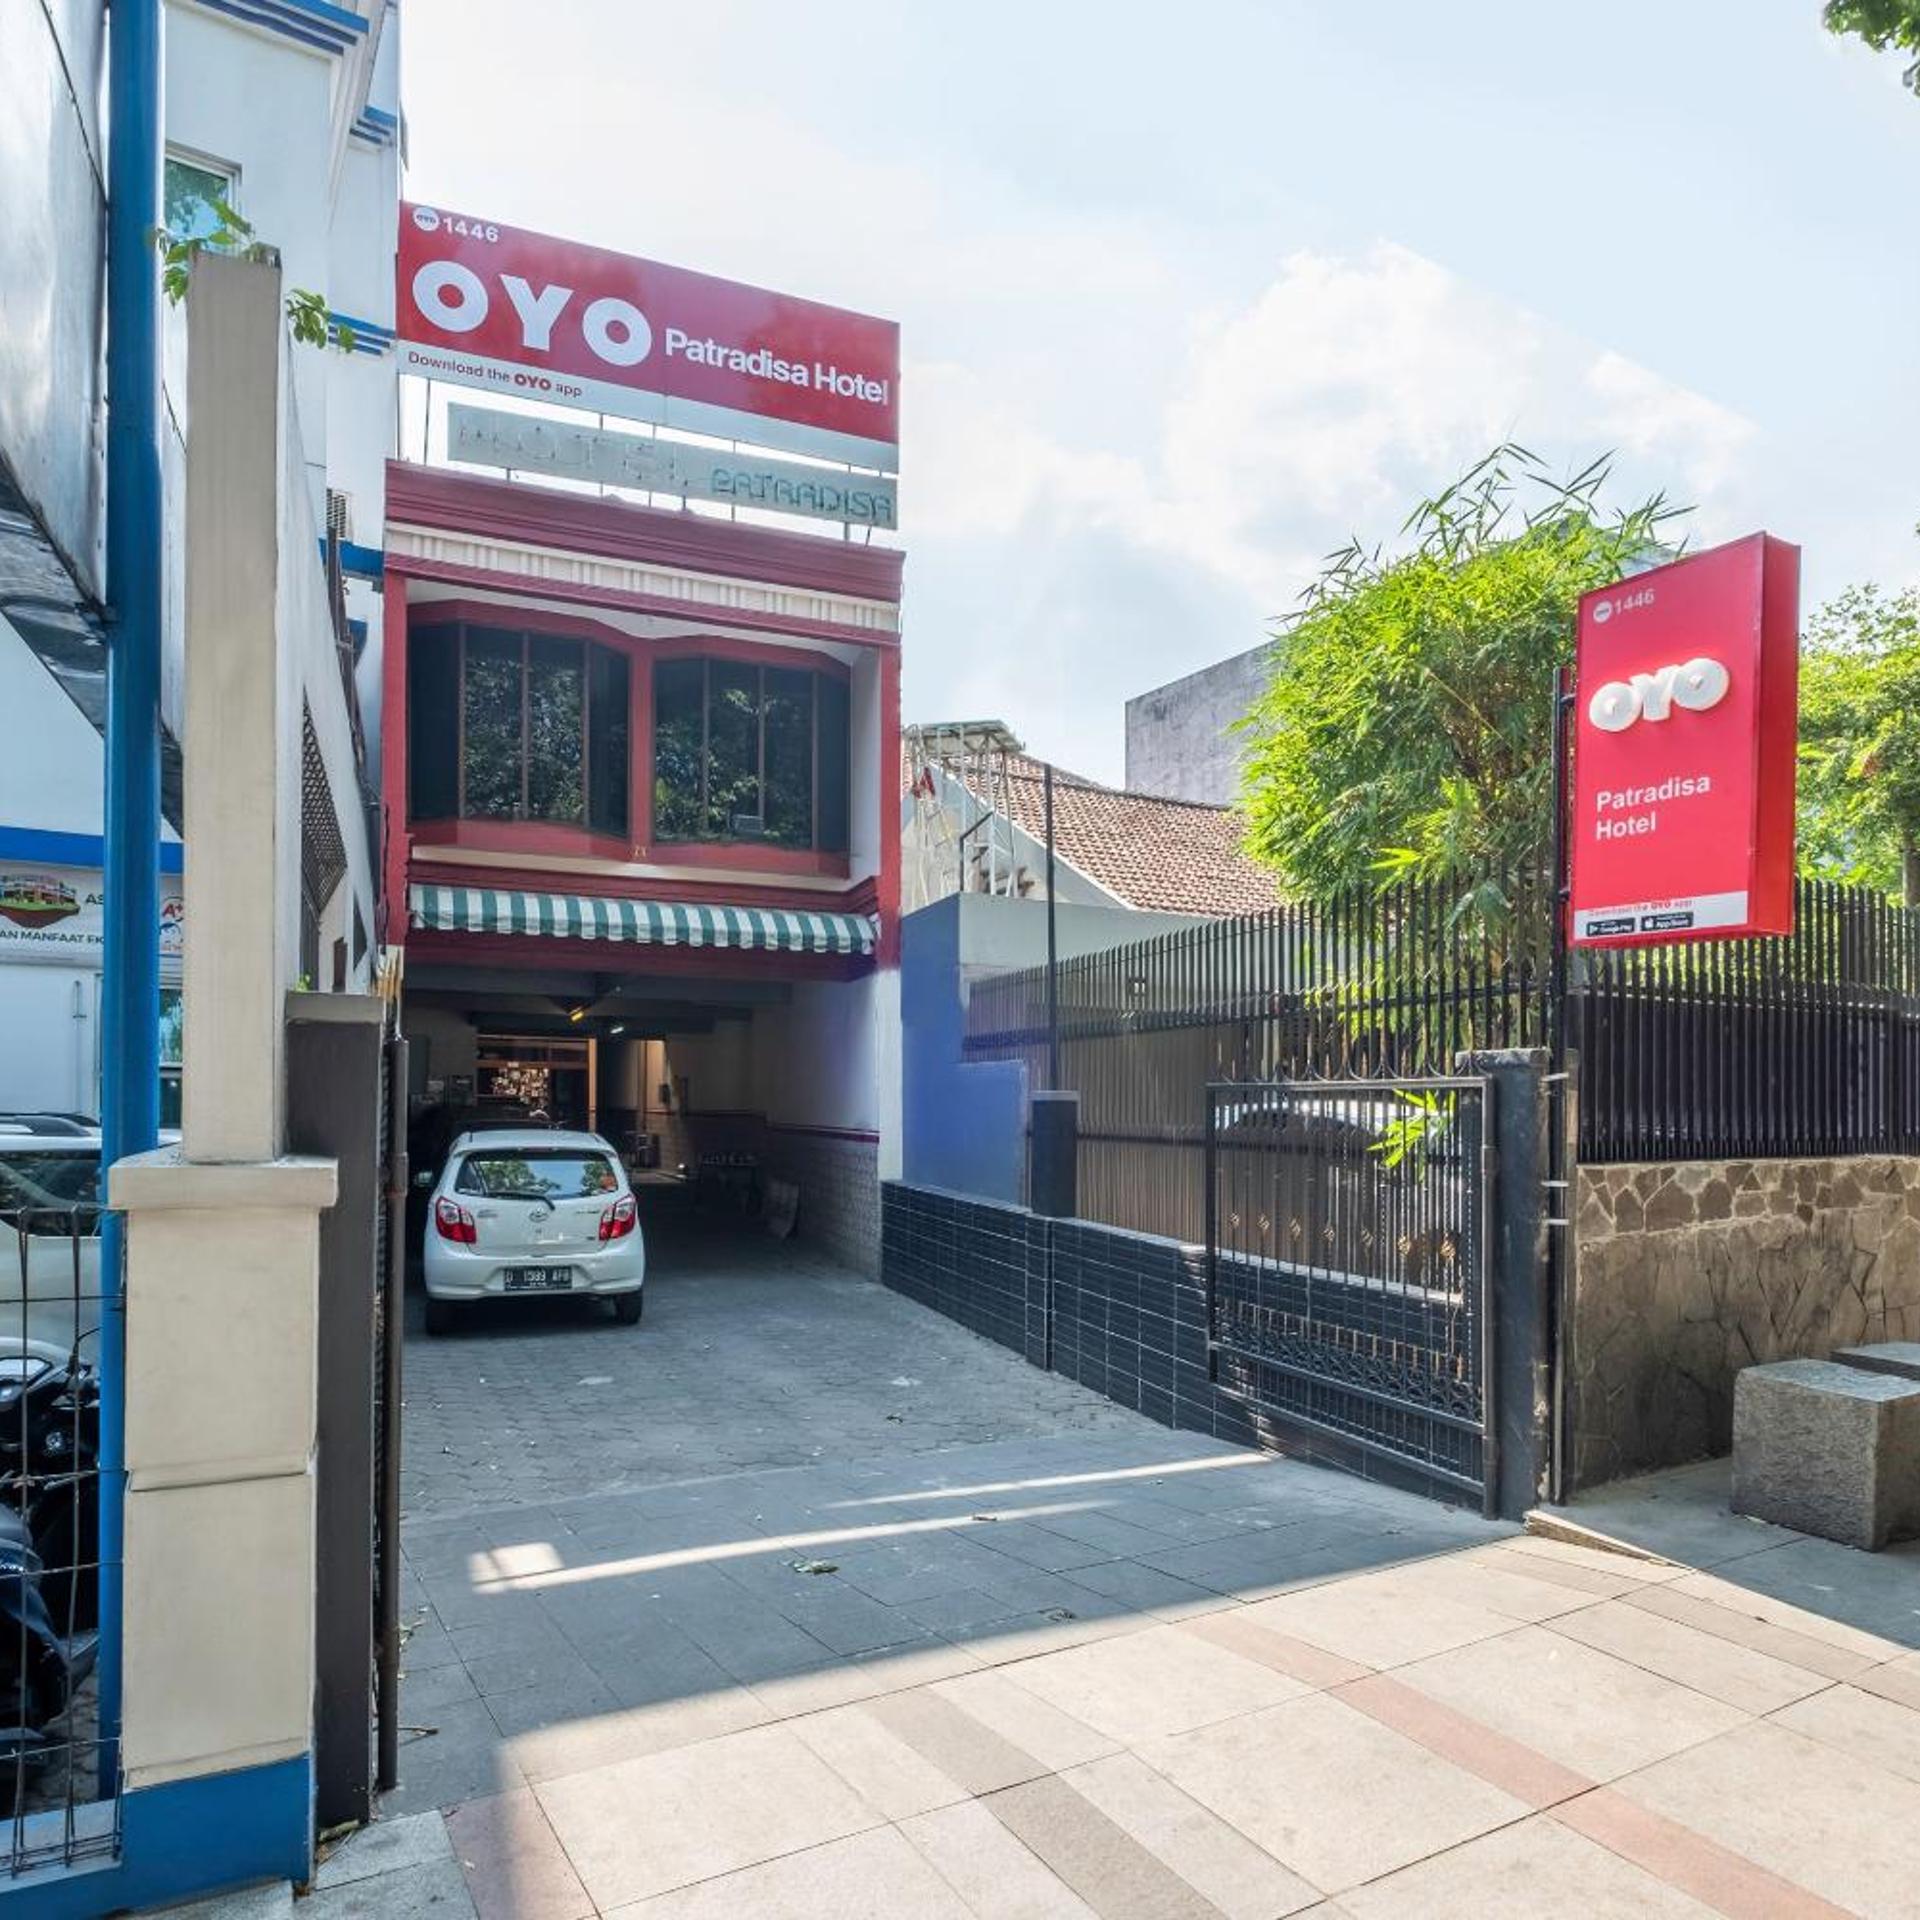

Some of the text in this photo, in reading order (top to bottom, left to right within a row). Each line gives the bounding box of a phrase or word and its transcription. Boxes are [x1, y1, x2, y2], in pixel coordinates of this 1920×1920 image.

[442, 216, 498, 243] 1446
[412, 260, 653, 368] OYO
[408, 351, 583, 398] Download the OYO app
[665, 327, 889, 406] Patradisa Hotel
[1614, 588, 1656, 615] 1446
[1588, 657, 1731, 732] OYO
[1595, 775, 1712, 812] Patradisa
[1595, 811, 1657, 841] Hotel
[20, 931, 85, 944] MANFAAT
